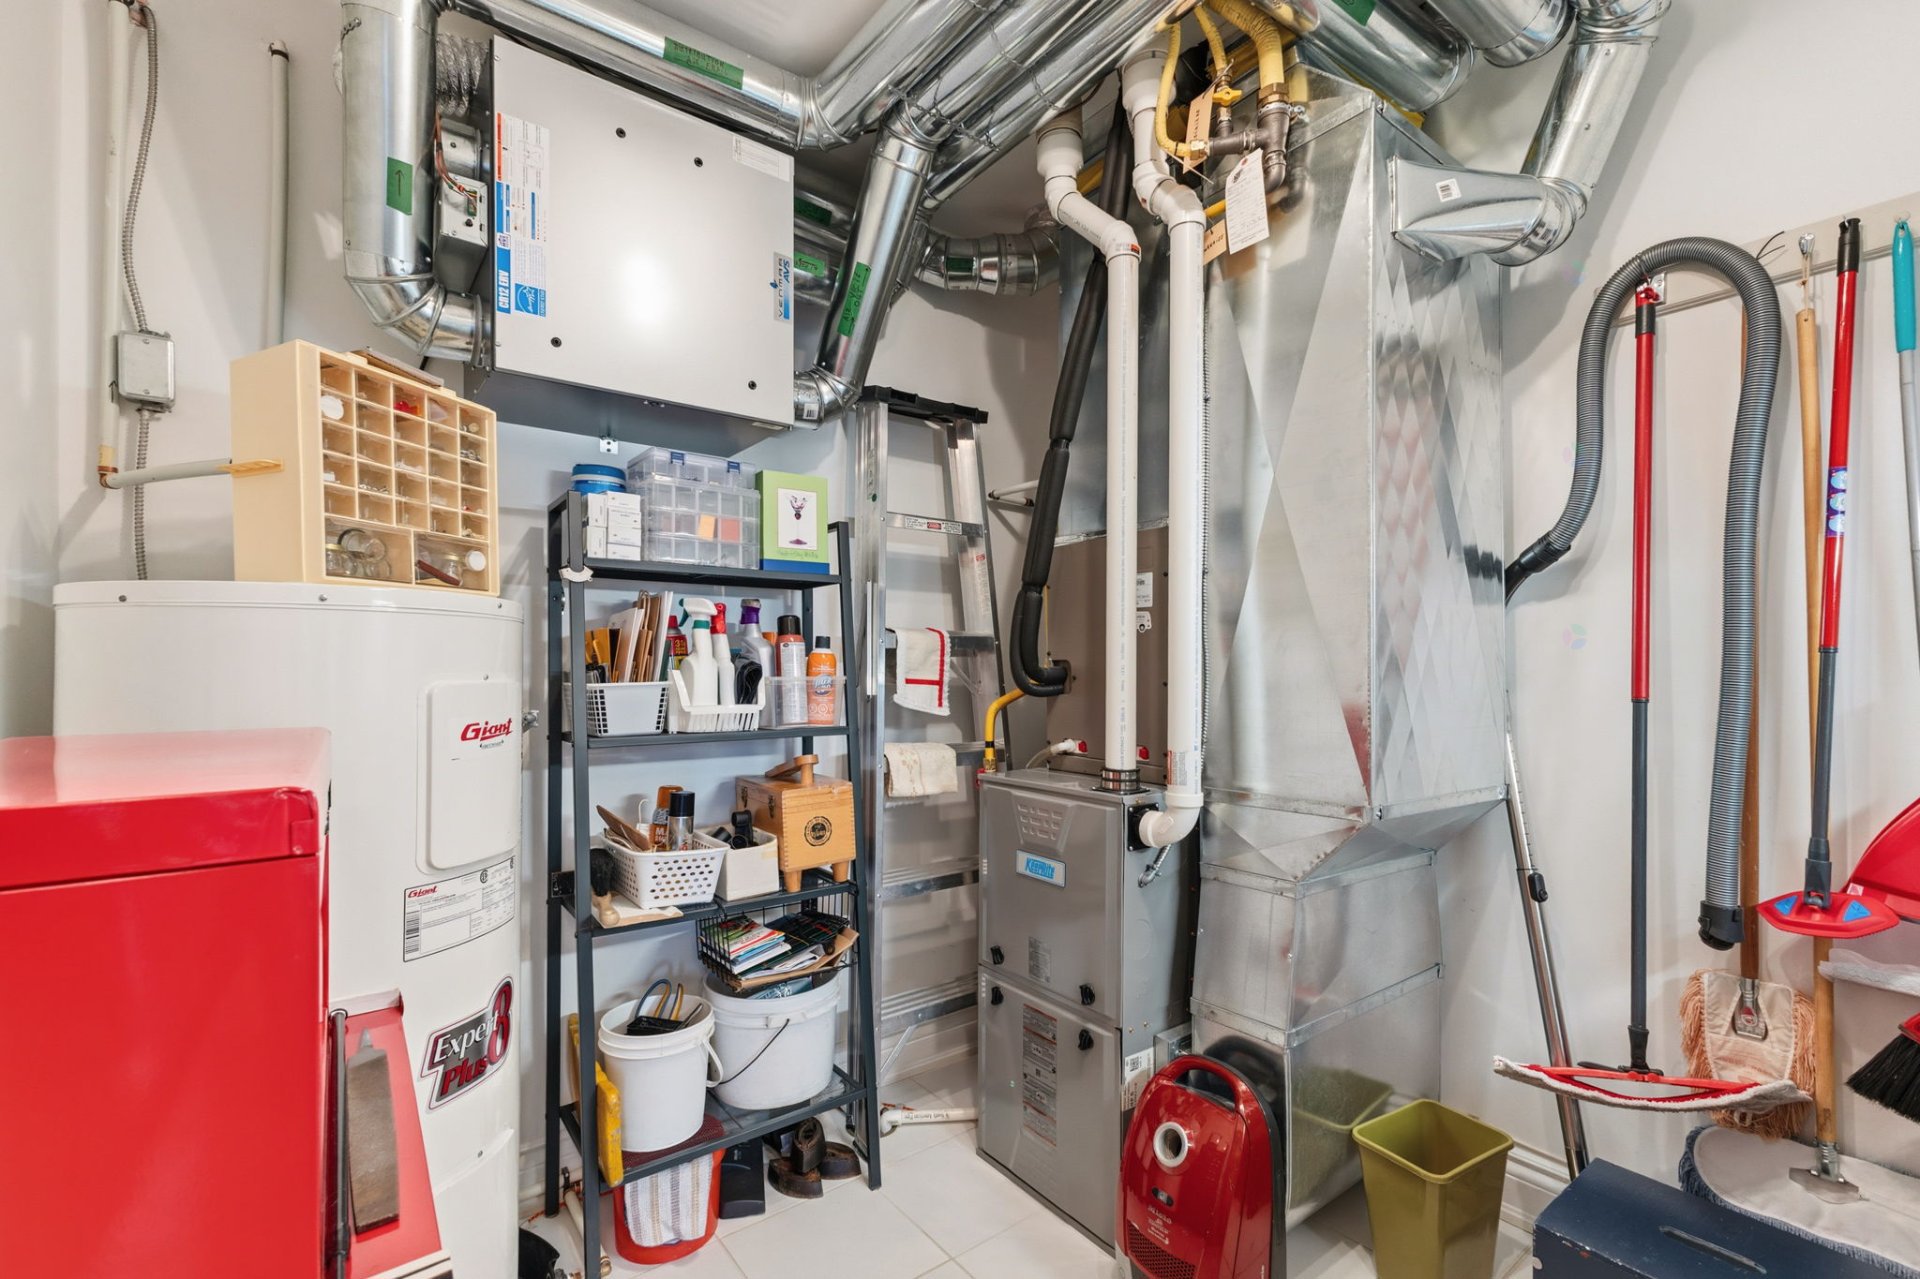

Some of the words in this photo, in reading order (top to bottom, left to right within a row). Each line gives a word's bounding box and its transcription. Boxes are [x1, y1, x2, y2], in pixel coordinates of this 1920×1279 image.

[460, 717, 513, 741] Giant
[408, 885, 437, 898] Giant
[433, 1010, 499, 1063] Expert
[440, 1057, 488, 1096] Plus
